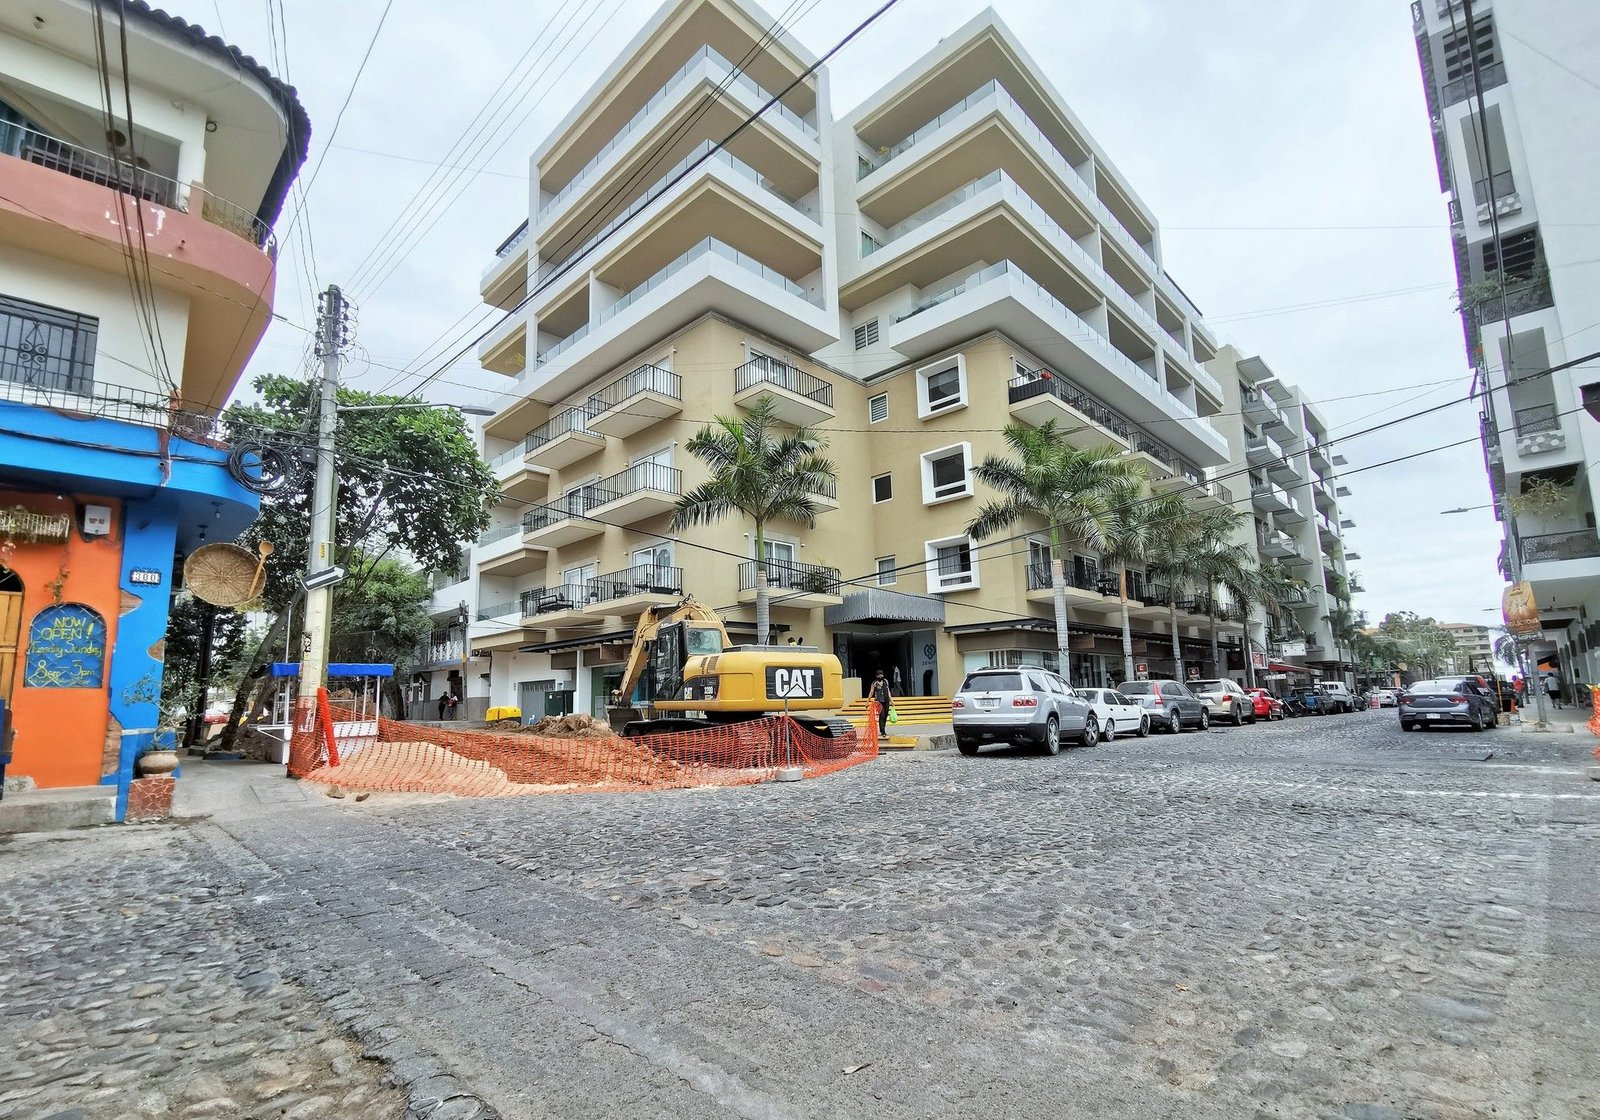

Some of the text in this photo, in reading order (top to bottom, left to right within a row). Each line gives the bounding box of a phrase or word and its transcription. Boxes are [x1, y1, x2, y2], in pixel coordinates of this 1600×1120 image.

[135, 572, 156, 581] 300
[54, 616, 87, 628] NOW
[775, 668, 815, 697] CAT
